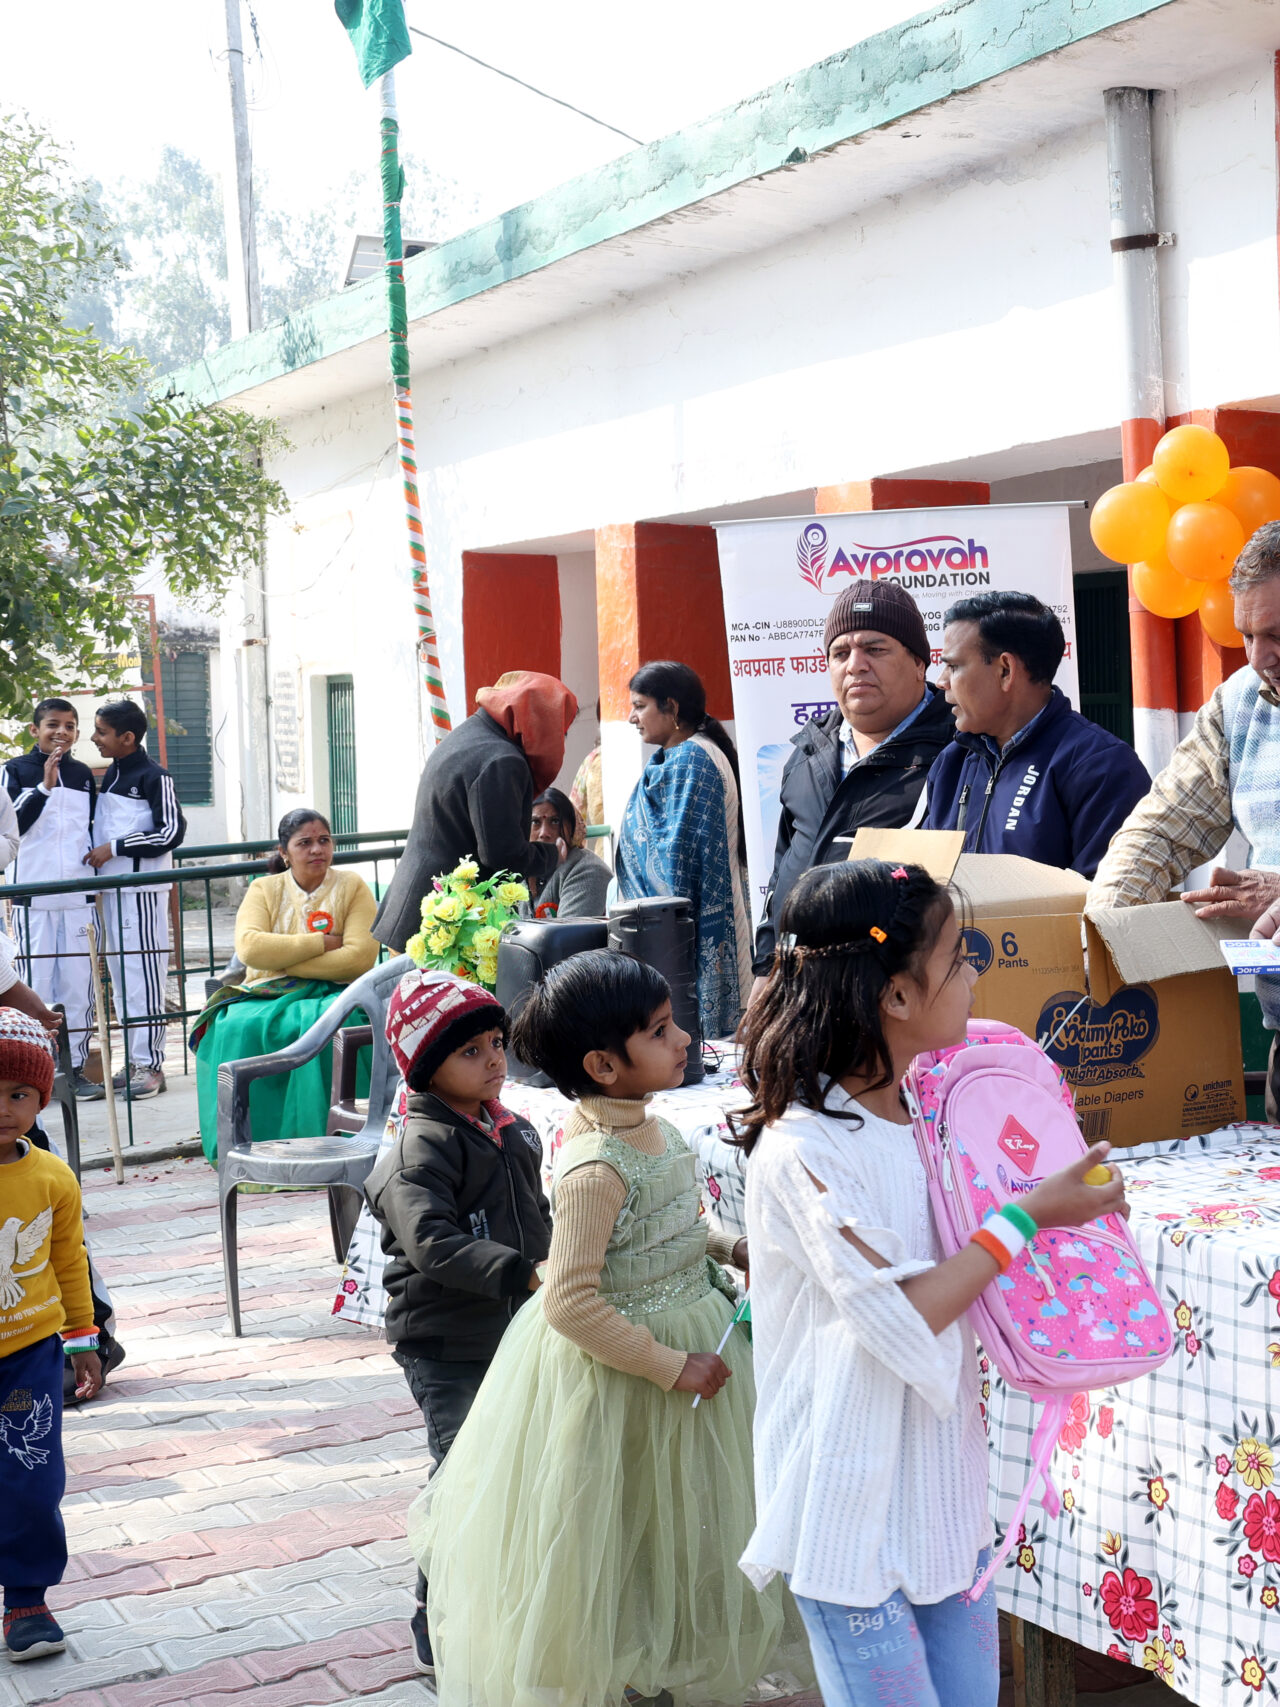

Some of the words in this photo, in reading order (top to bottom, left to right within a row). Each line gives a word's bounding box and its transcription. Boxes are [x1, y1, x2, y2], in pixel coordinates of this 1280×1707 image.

[827, 539, 989, 581] Avpravah
[731, 623, 750, 631] MCA
[730, 634, 746, 643] PAN
[748, 634, 760, 642] No
[733, 657, 786, 677] अवप्रवाह
[1005, 765, 1040, 831] JORDAN
[1001, 931, 1018, 957] 6
[998, 957, 1029, 968] Pants
[1080, 1041, 1124, 1065] pants
[1097, 1063, 1139, 1081] Absorb
[1203, 1080, 1232, 1091] unicharm
[1104, 1089, 1144, 1104] Diapers
[846, 1612, 885, 1637] Big
[856, 1633, 908, 1660] STYLE
